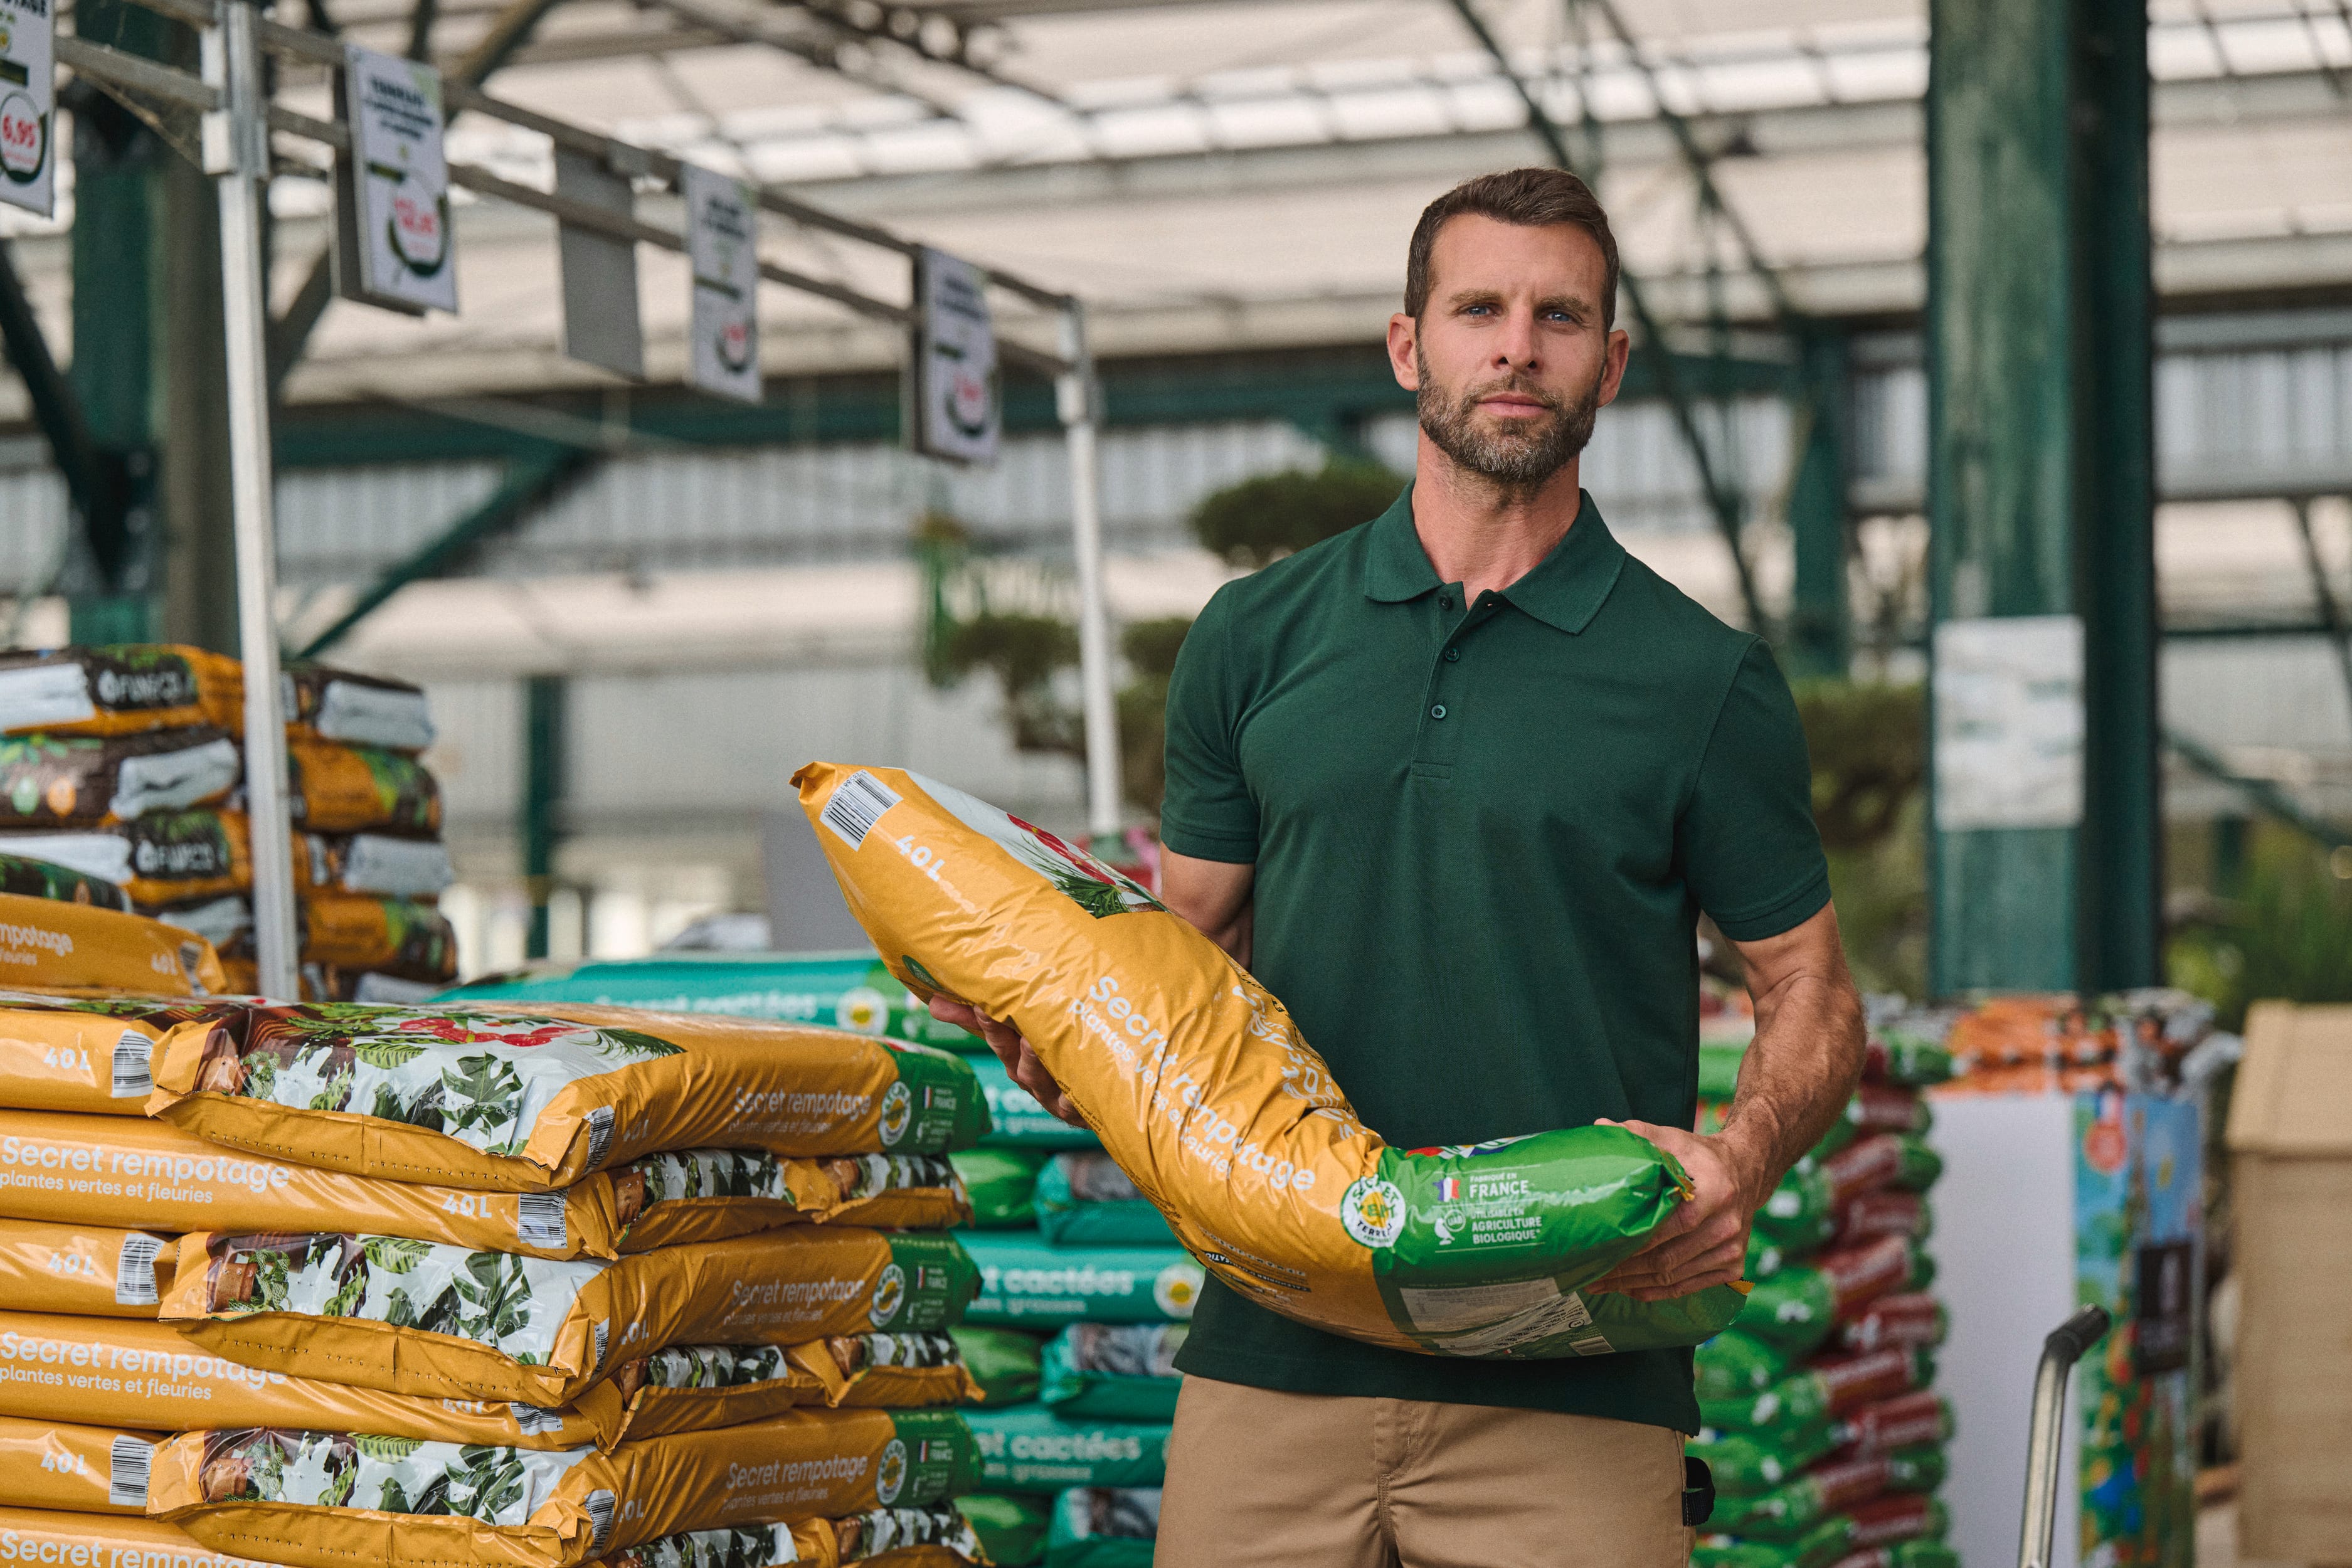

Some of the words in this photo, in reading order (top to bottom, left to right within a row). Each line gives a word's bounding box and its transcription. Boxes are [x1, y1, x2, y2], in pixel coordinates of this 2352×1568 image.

[1067, 999, 1135, 1062] plantes
[1089, 976, 1179, 1076] Secret
[733, 1086, 786, 1113] Secret
[787, 1089, 872, 1122] rempotage
[1, 1136, 105, 1173] Secret
[112, 1155, 290, 1193] rempotage
[0, 1169, 64, 1190] plantes
[68, 1177, 122, 1197] vertes
[125, 1183, 144, 1199] et
[147, 1182, 213, 1204] fleuries
[1470, 1180, 1529, 1199] FRANCE
[1471, 1216, 1543, 1232] AGRICULTURE
[732, 1278, 780, 1307] Secret
[1, 1331, 102, 1368] Secret
[0, 1364, 63, 1386] plantes
[68, 1373, 121, 1392] vertes
[125, 1378, 144, 1394] et
[146, 1377, 212, 1400] fleuries
[726, 1459, 781, 1490] Secret
[781, 1453, 869, 1487] rempotage
[1, 1530, 103, 1567] Secret
